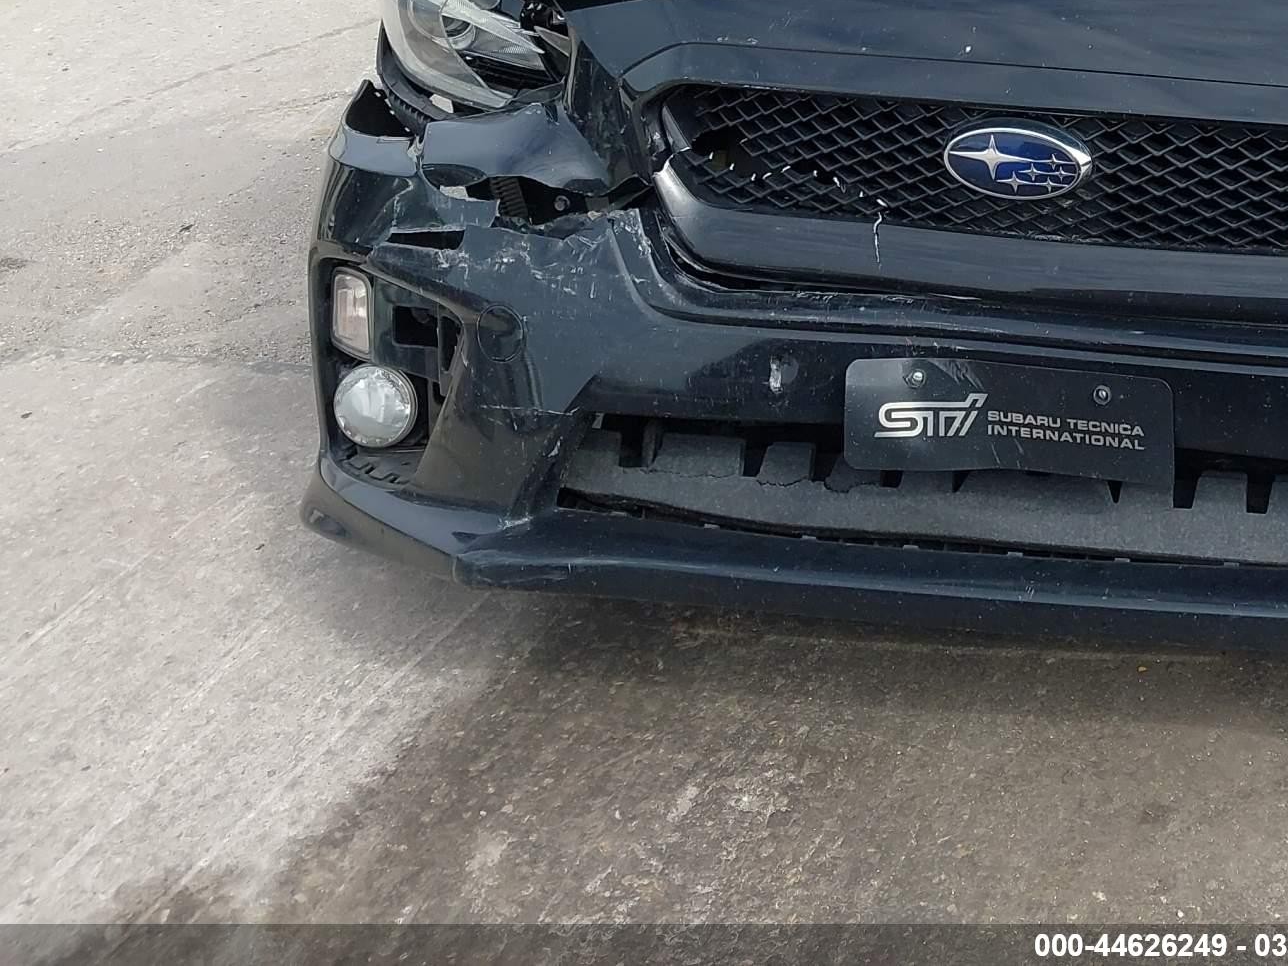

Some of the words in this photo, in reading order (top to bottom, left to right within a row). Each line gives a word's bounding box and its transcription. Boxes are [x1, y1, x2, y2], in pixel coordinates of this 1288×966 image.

[987, 410, 1061, 428] SUBARU
[1067, 418, 1145, 437] TECNICA
[987, 425, 1146, 451] INTERNATIONAL
